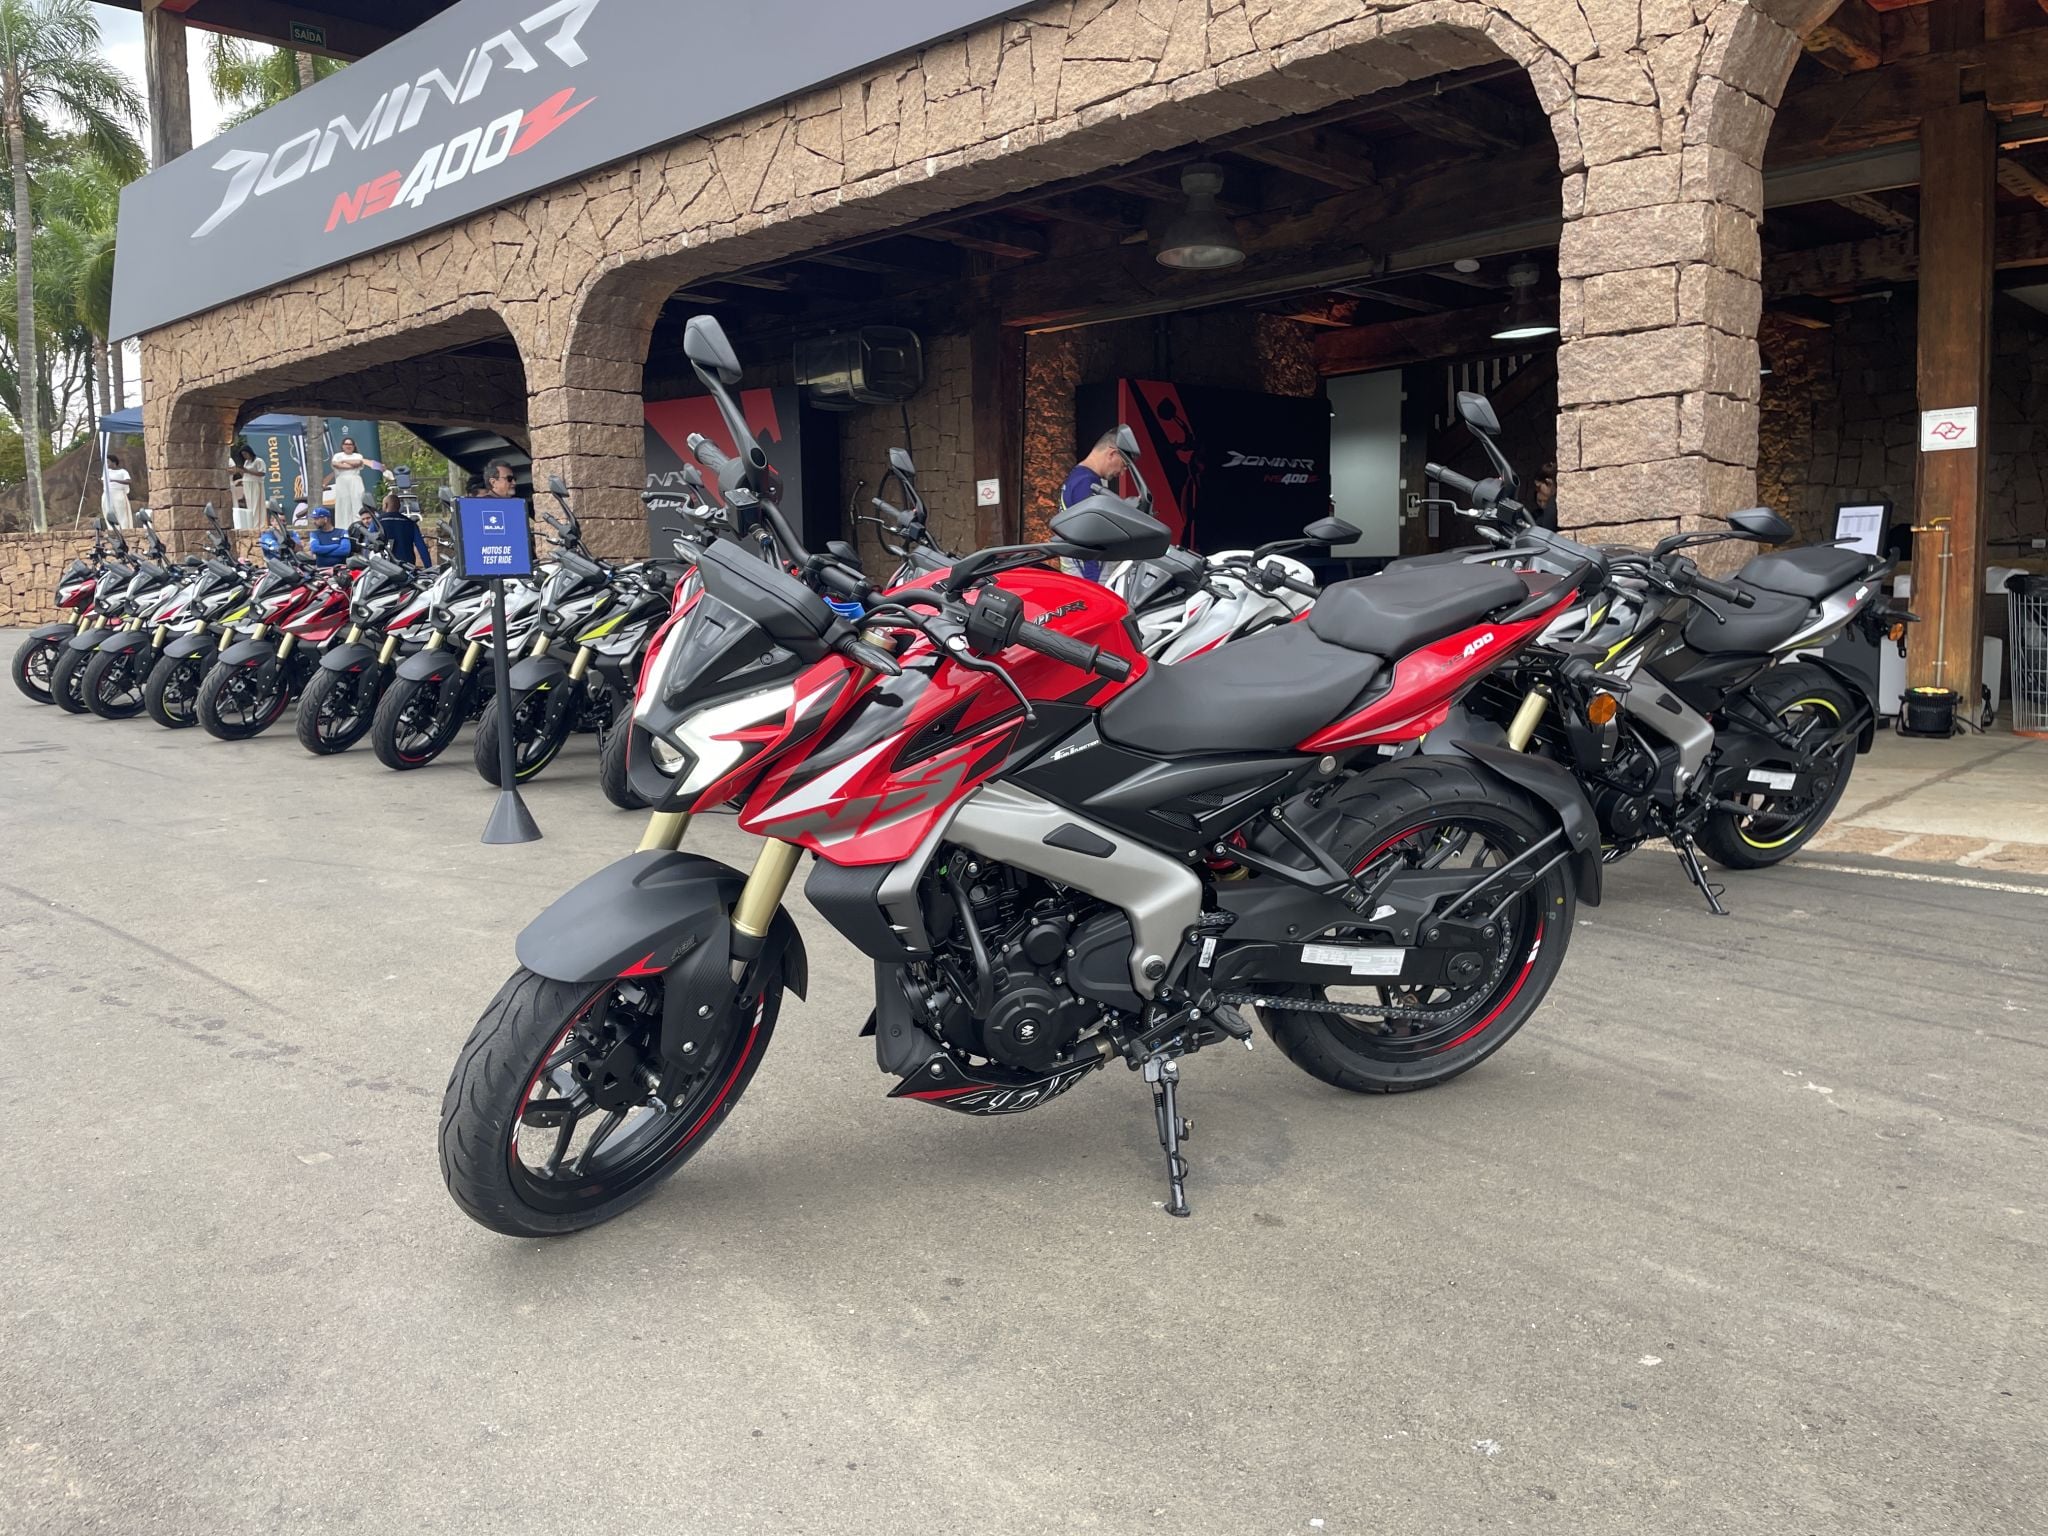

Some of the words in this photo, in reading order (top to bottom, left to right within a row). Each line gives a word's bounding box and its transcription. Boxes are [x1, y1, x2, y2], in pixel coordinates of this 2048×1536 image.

[294, 28, 322, 43] SAÍDA
[190, 0, 601, 238] DOMINAR
[268, 436, 281, 483] bluma
[1221, 450, 1315, 471] DOMINAR
[481, 545, 502, 555] MOTOS
[503, 545, 511, 555] DE
[483, 555, 497, 565] TEST
[498, 555, 512, 565] RIDE
